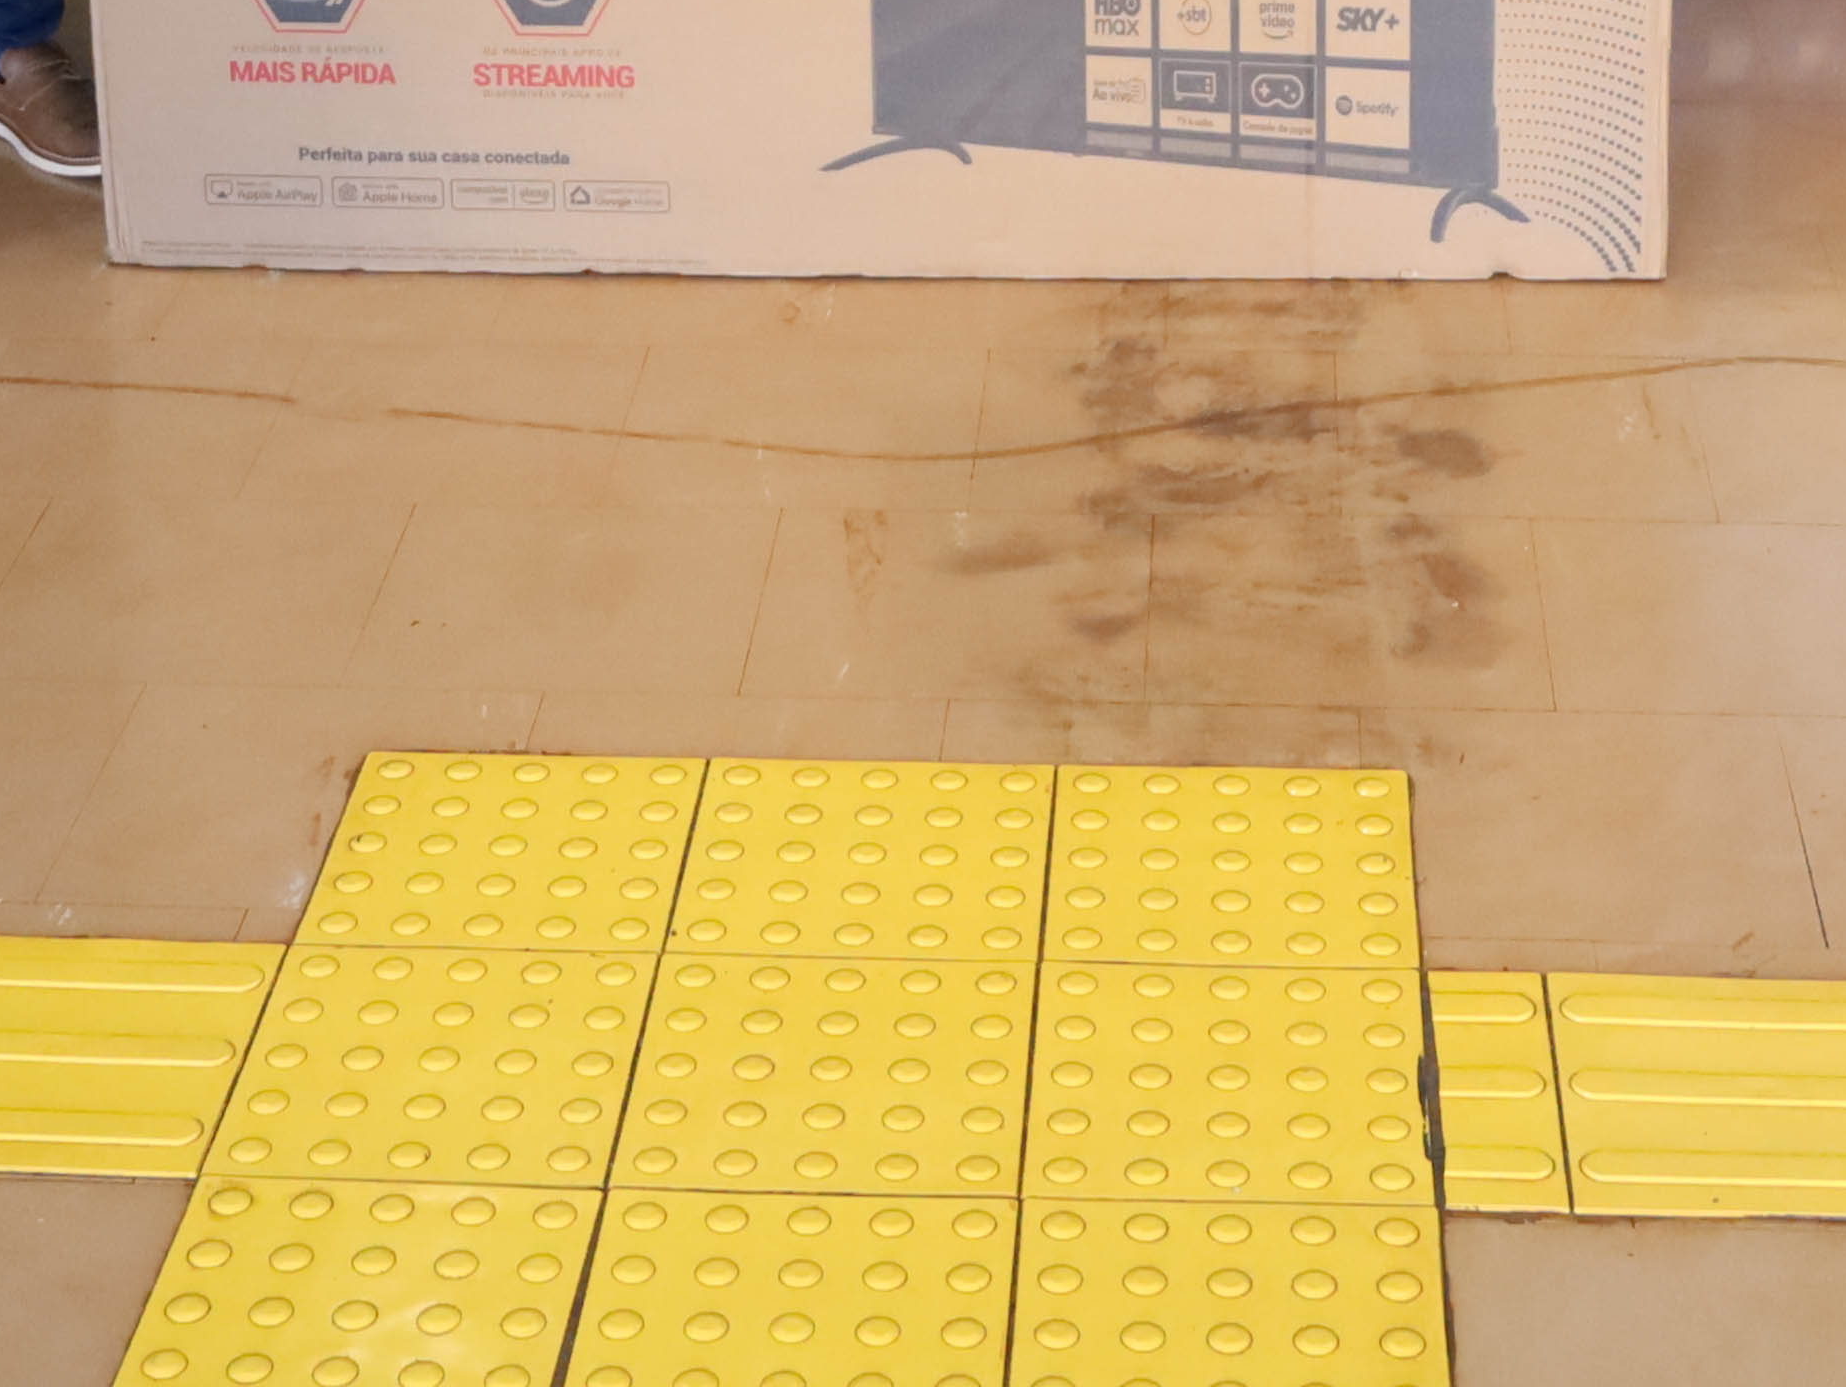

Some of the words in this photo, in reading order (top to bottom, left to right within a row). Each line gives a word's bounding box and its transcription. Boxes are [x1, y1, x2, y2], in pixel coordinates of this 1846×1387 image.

[1259, 0, 1296, 16] prime
[1094, 17, 1140, 38] max
[1260, 13, 1296, 29] video
[229, 60, 295, 84] MAIS
[301, 56, 396, 85] RÁPIDA
[473, 61, 636, 89] STREAMING
[1355, 98, 1399, 118] Spotify
[298, 145, 363, 163] Perfeita
[367, 150, 404, 165] para
[407, 151, 438, 163] sua
[441, 152, 480, 164] casa
[484, 150, 571, 165] conectada
